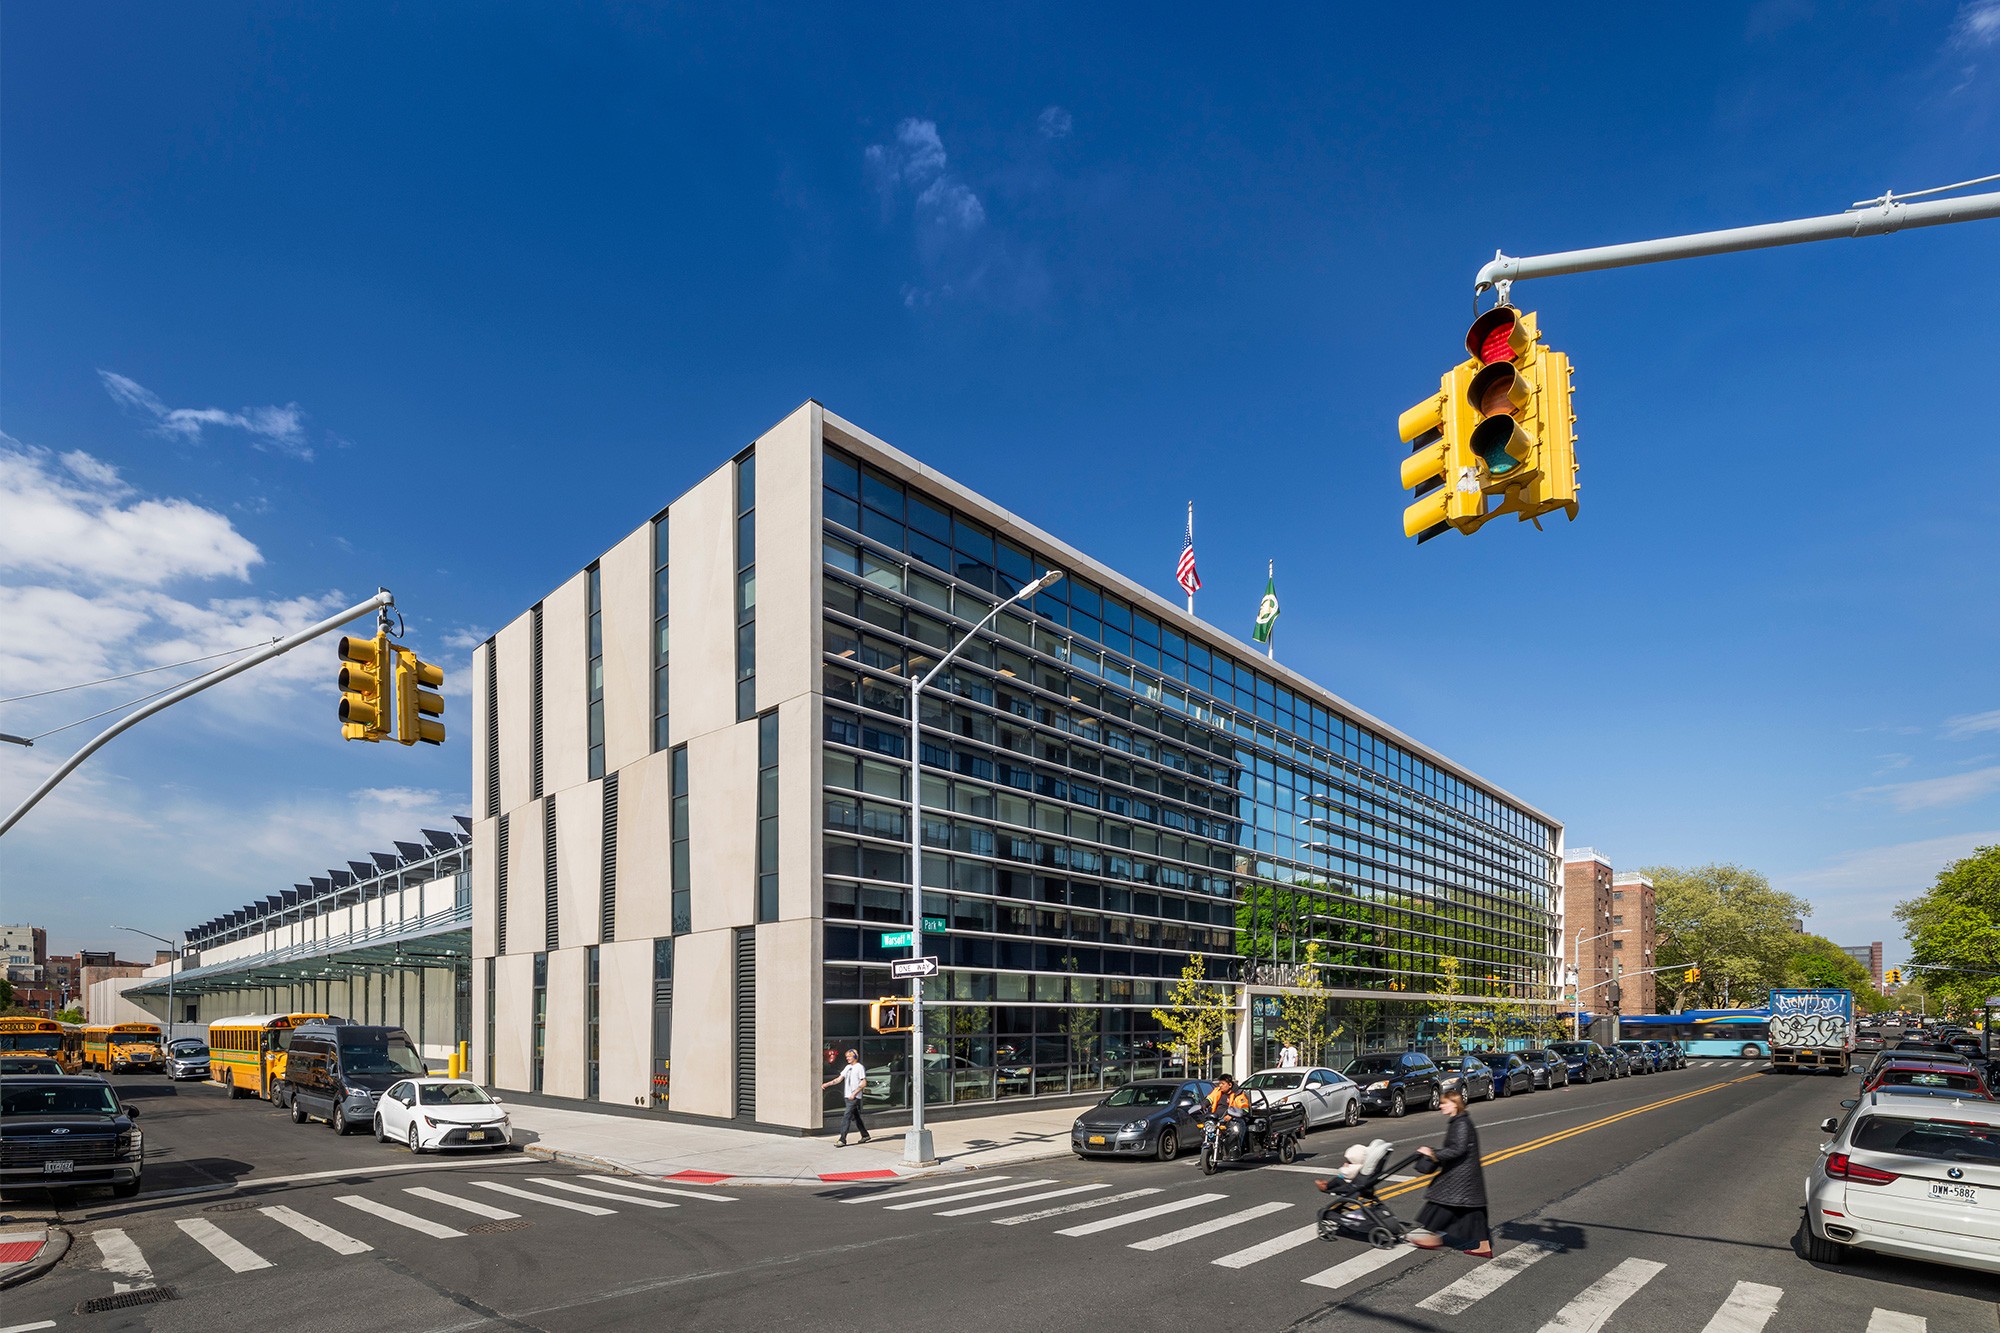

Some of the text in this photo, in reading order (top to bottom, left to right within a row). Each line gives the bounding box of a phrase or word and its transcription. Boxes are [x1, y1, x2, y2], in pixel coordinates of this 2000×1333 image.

[924, 920, 936, 930] Park
[883, 934, 906, 946] Warsoff
[898, 963, 930, 973] ONE WAY
